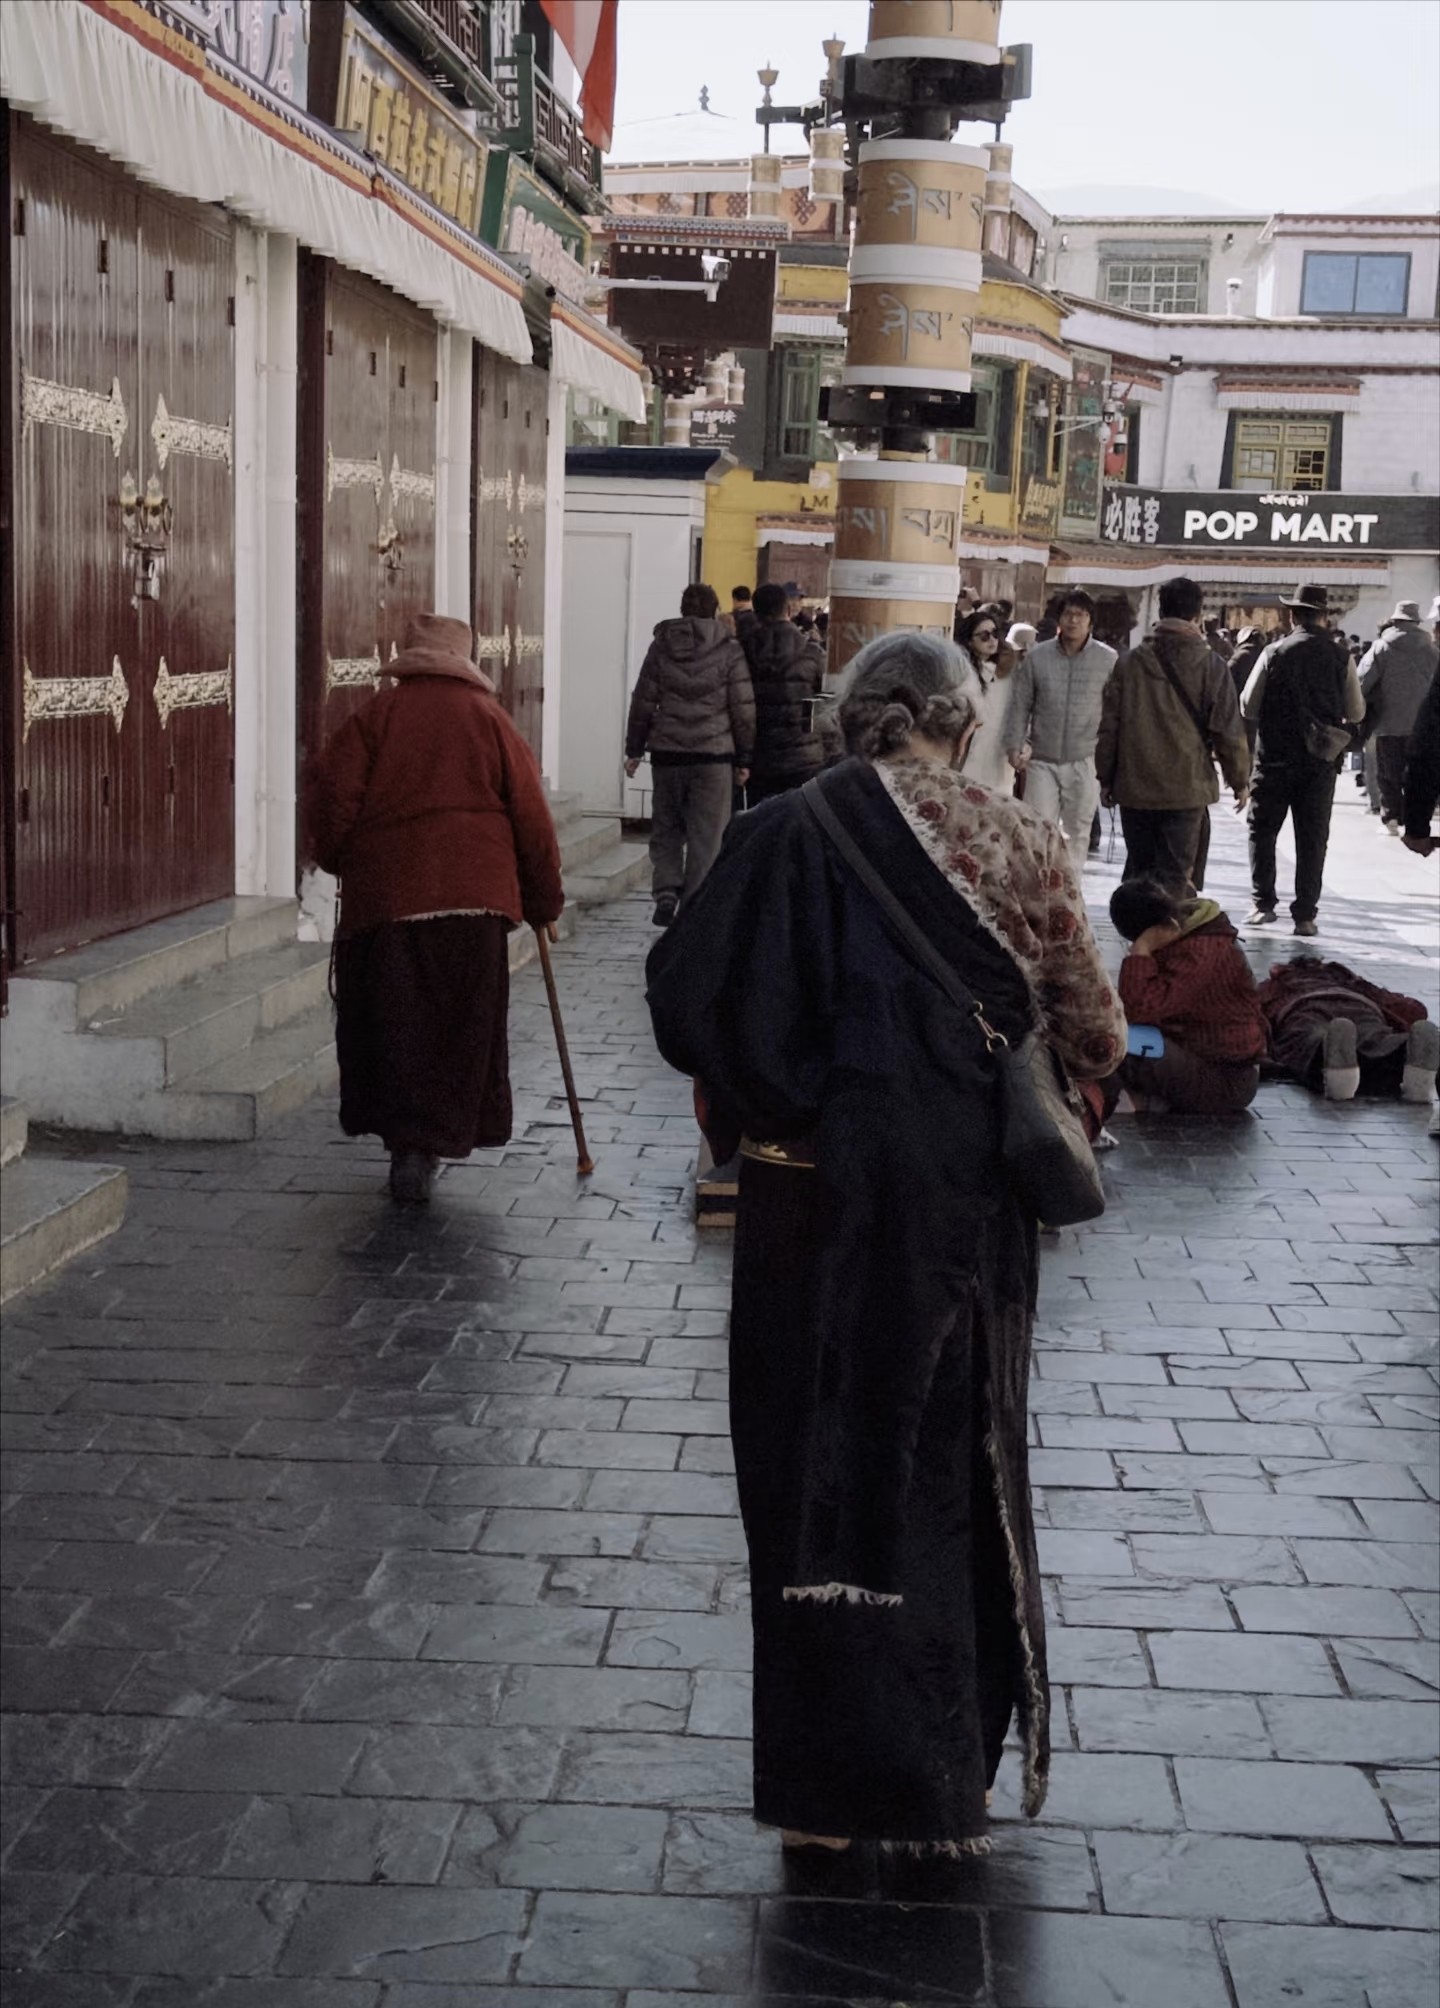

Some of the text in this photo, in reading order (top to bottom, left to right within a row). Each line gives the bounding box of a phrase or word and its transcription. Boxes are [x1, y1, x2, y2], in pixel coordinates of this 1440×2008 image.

[1105, 492, 1160, 543] 必胜客
[1184, 510, 1378, 544] POP MART
